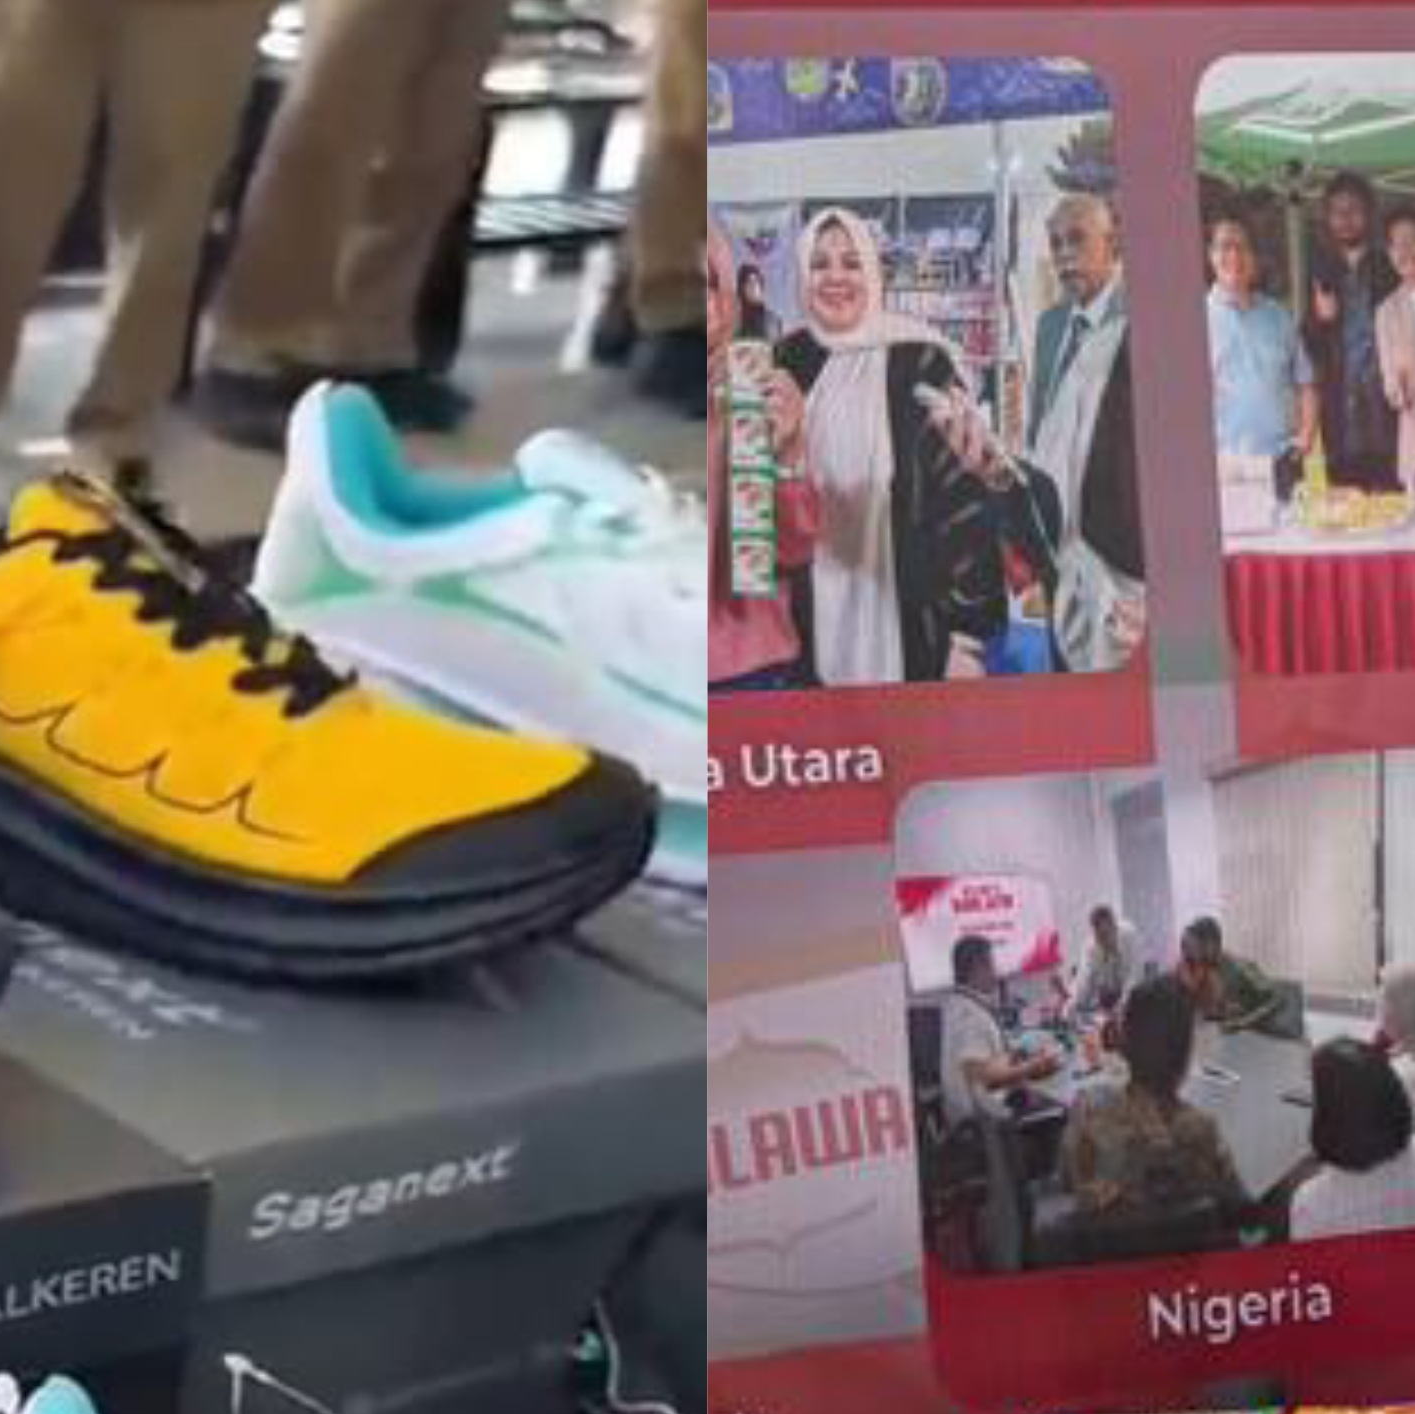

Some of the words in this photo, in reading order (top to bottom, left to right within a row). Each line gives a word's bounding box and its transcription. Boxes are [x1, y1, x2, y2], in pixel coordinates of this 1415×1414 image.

[740, 743, 883, 788] Utara
[707, 1084, 908, 1197] LAWA
[248, 1135, 520, 1239] Saganext
[1147, 1271, 1334, 1345] Nigeria
